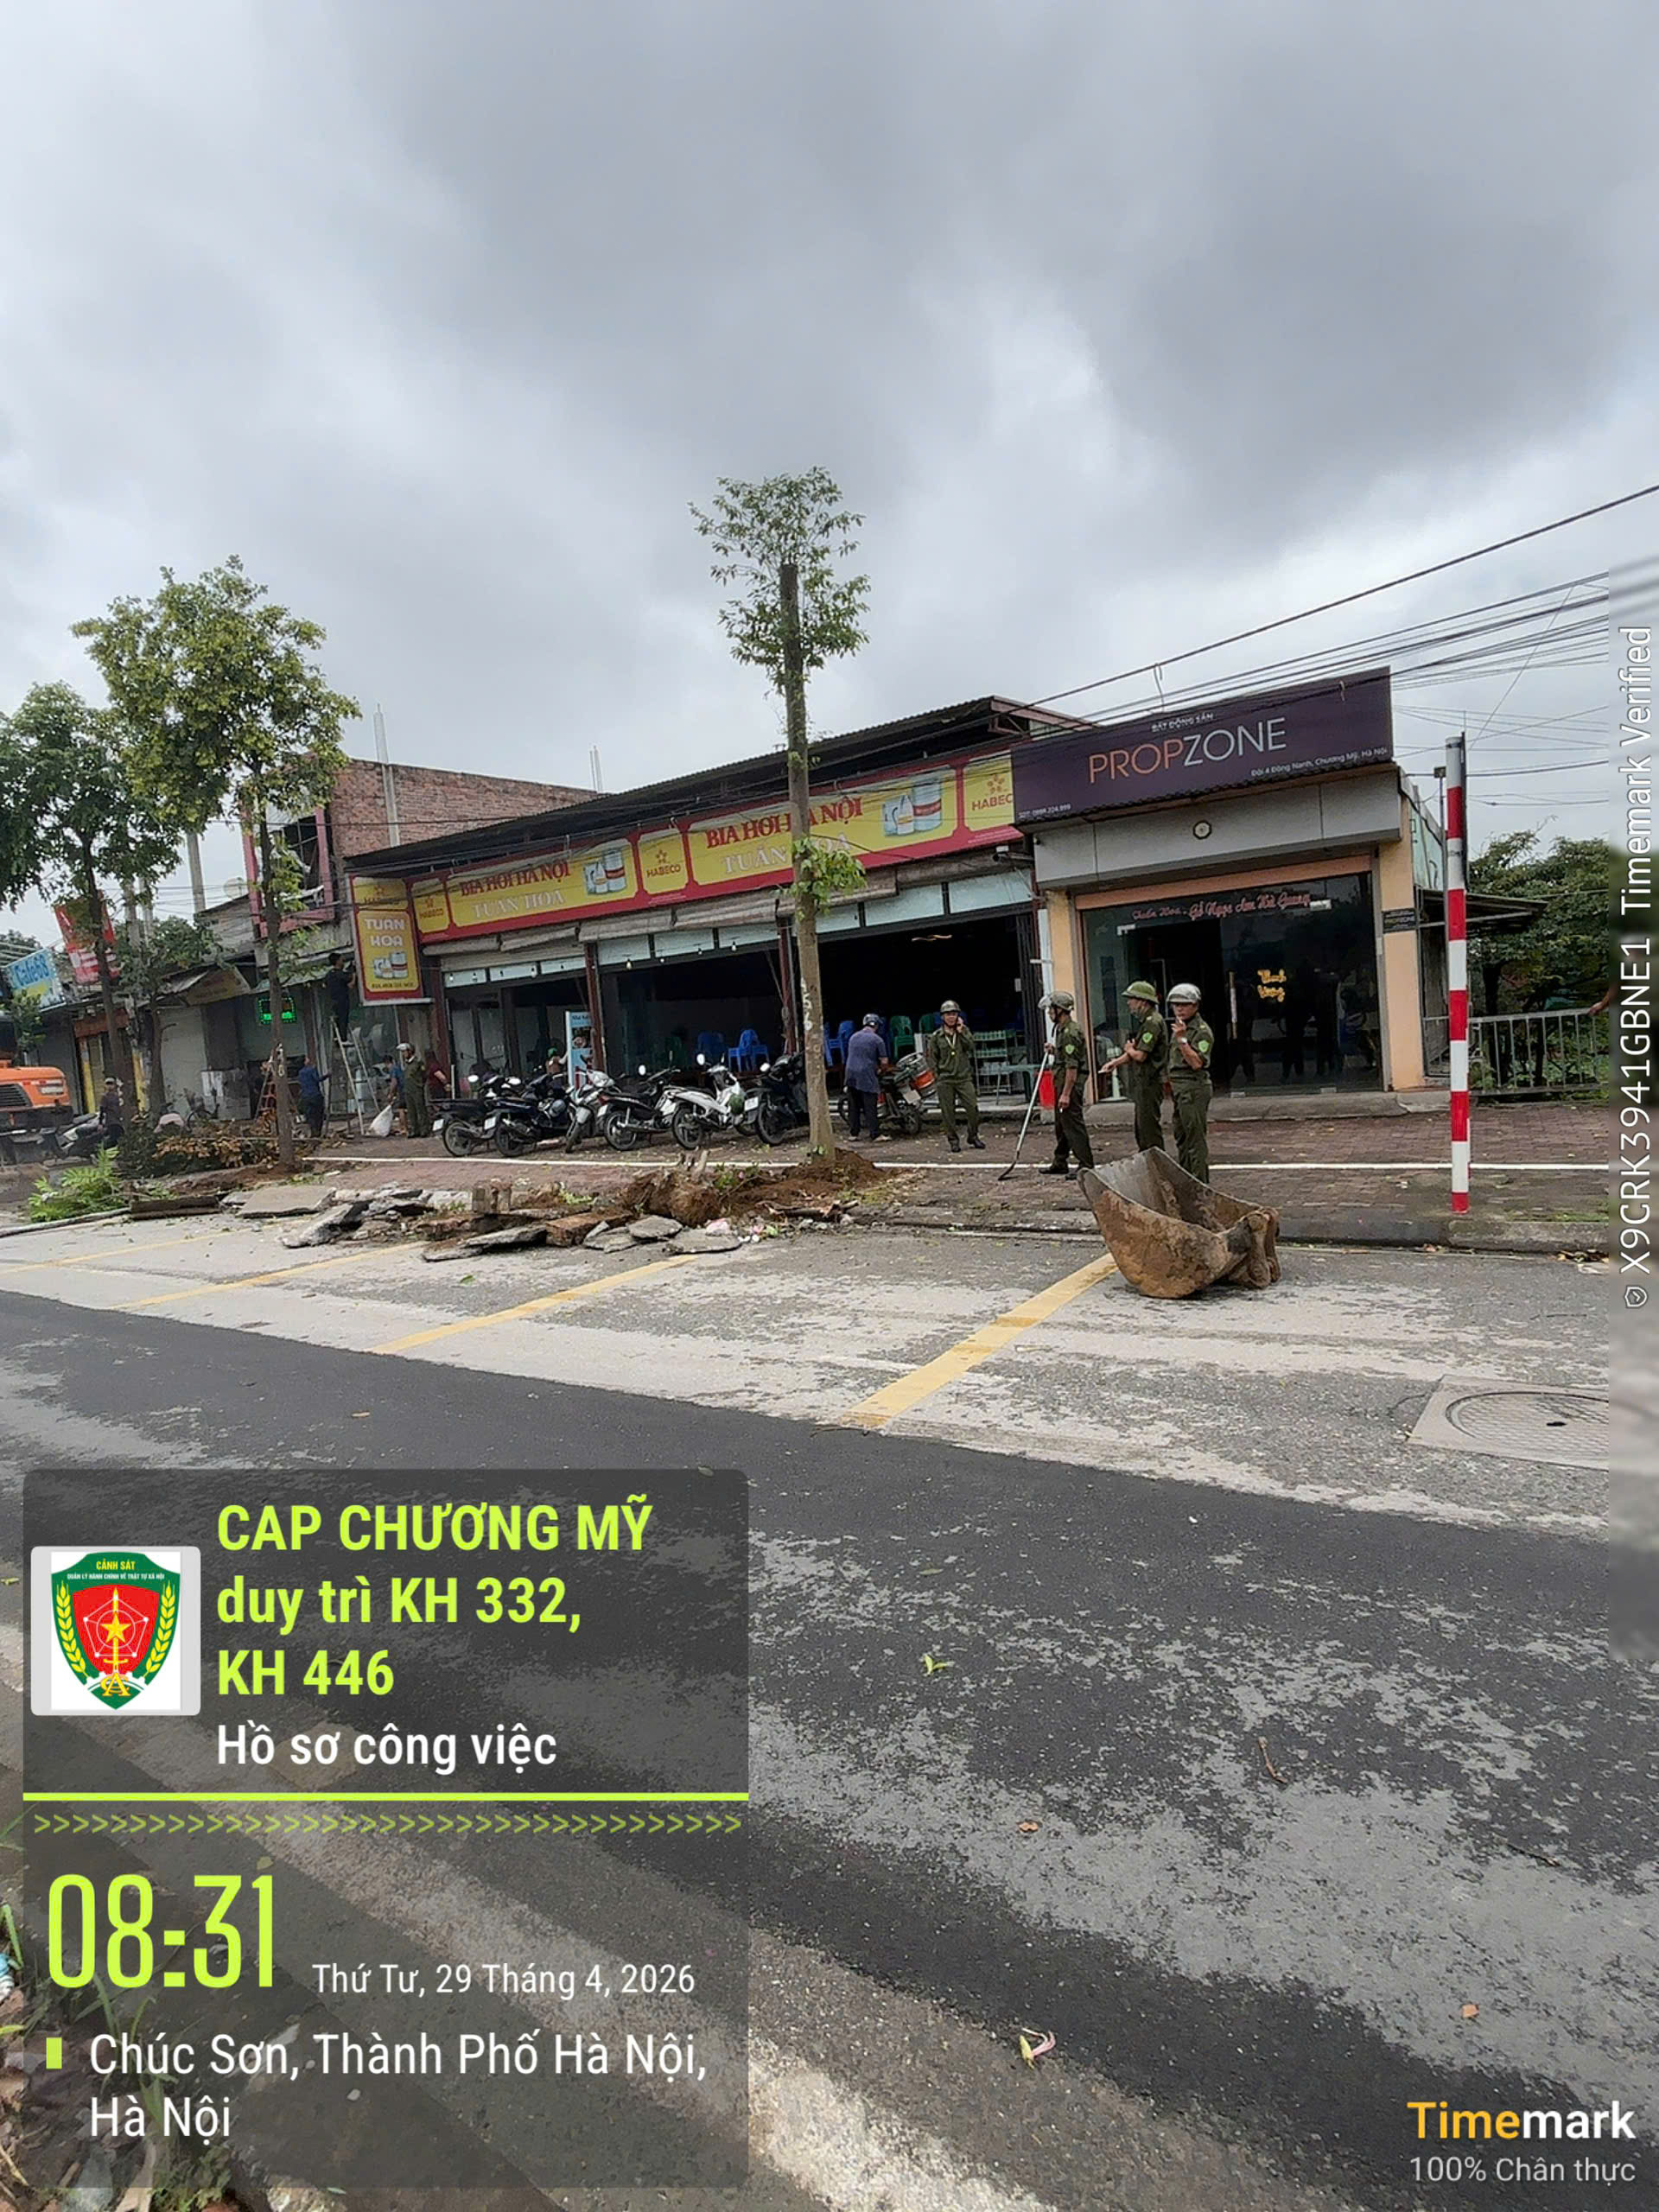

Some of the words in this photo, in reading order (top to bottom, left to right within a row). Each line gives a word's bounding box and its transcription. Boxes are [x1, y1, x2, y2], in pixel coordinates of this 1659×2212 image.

[1088, 716, 1287, 784] PROPZONE
[971, 793, 1014, 810] HABEC
[705, 828, 741, 849] BIA
[820, 795, 864, 825] NỘI
[646, 864, 682, 879] HABECO
[459, 879, 484, 897] BIA
